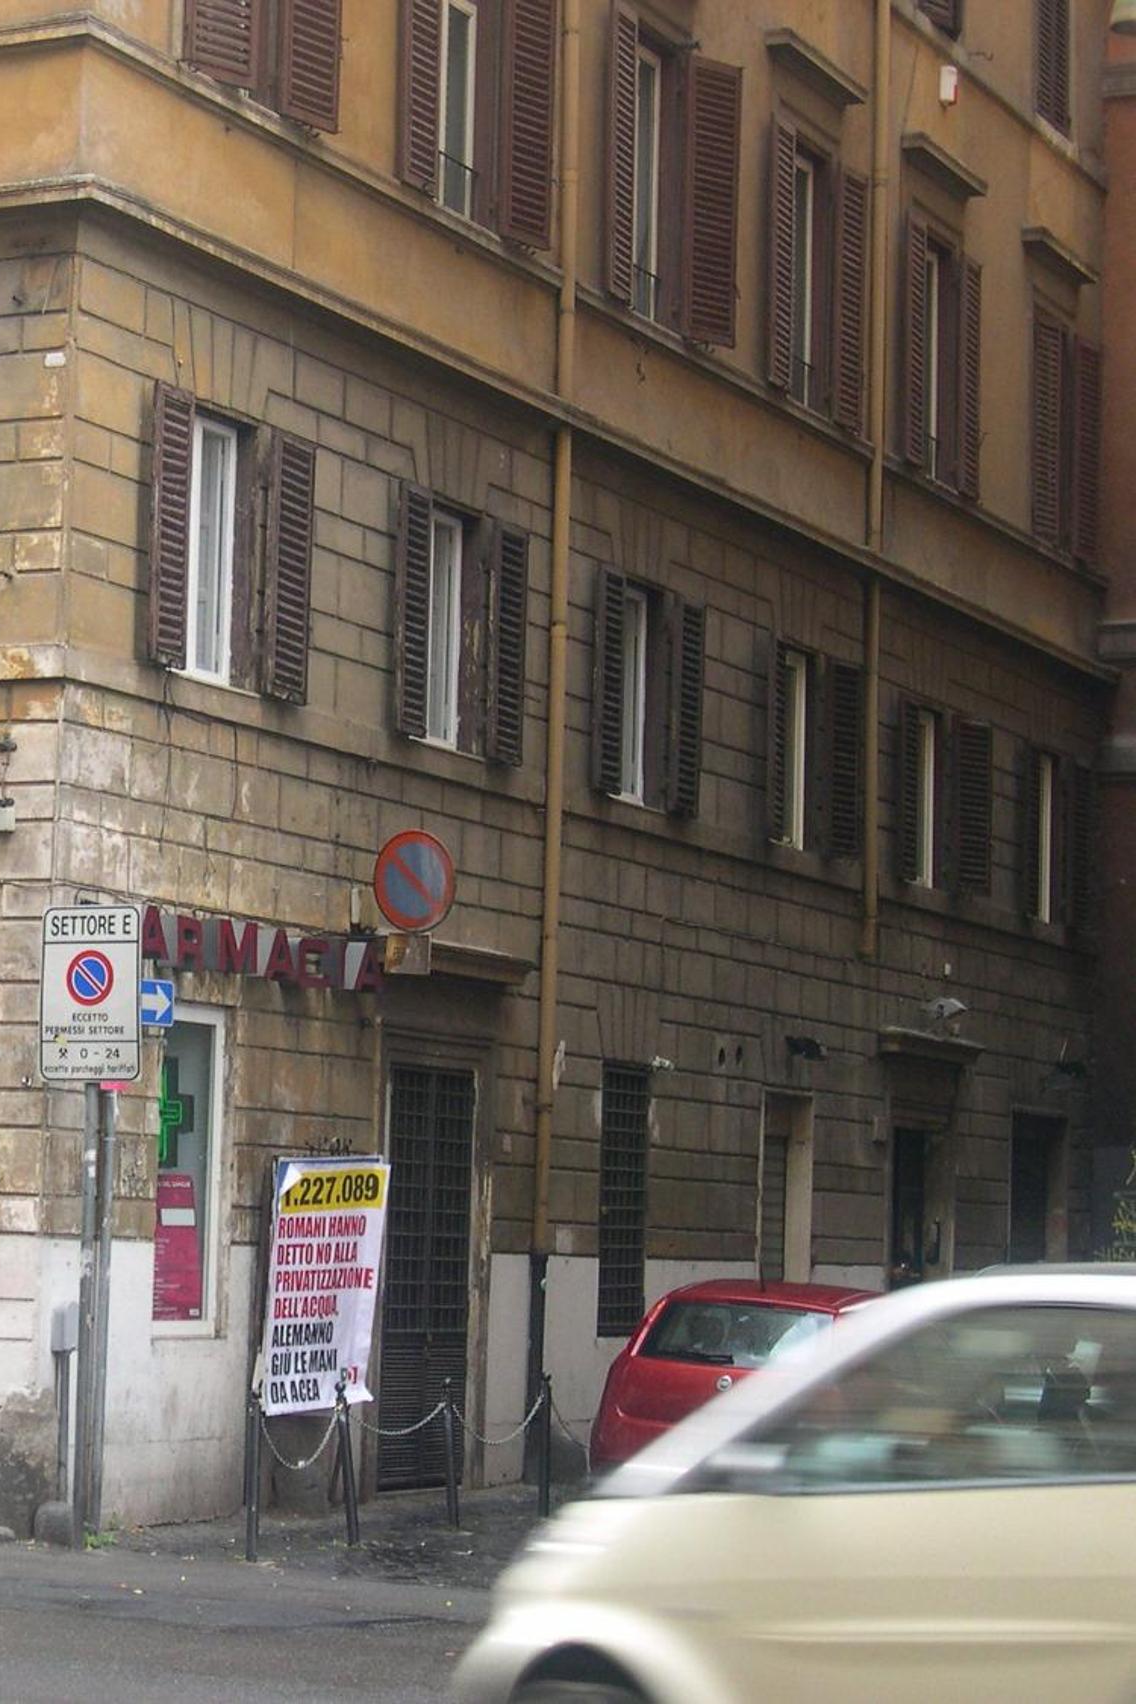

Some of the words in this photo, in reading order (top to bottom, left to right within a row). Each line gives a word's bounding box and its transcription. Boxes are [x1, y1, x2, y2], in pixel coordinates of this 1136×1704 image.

[50, 914, 116, 937] SETTORE
[122, 914, 132, 935] E
[142, 904, 385, 992] ARMACIA
[44, 1025, 84, 1036] PERMESSI
[88, 1025, 125, 1036] SETTORE
[72, 1012, 109, 1023] ECCETTO
[105, 1047, 121, 1060] 24
[277, 1215, 326, 1239] ROMANI
[328, 1214, 367, 1237] HANNO
[276, 1243, 313, 1267] DETTO
[315, 1242, 332, 1265] NO
[333, 1241, 358, 1263] ALLA
[274, 1267, 375, 1293] PRIVATIZZAZIONE
[271, 1321, 334, 1348] ALEMANNO
[293, 1351, 308, 1375] LE
[308, 1348, 338, 1373] MANI
[270, 1381, 289, 1405] DA
[289, 1377, 321, 1403] ACEA
